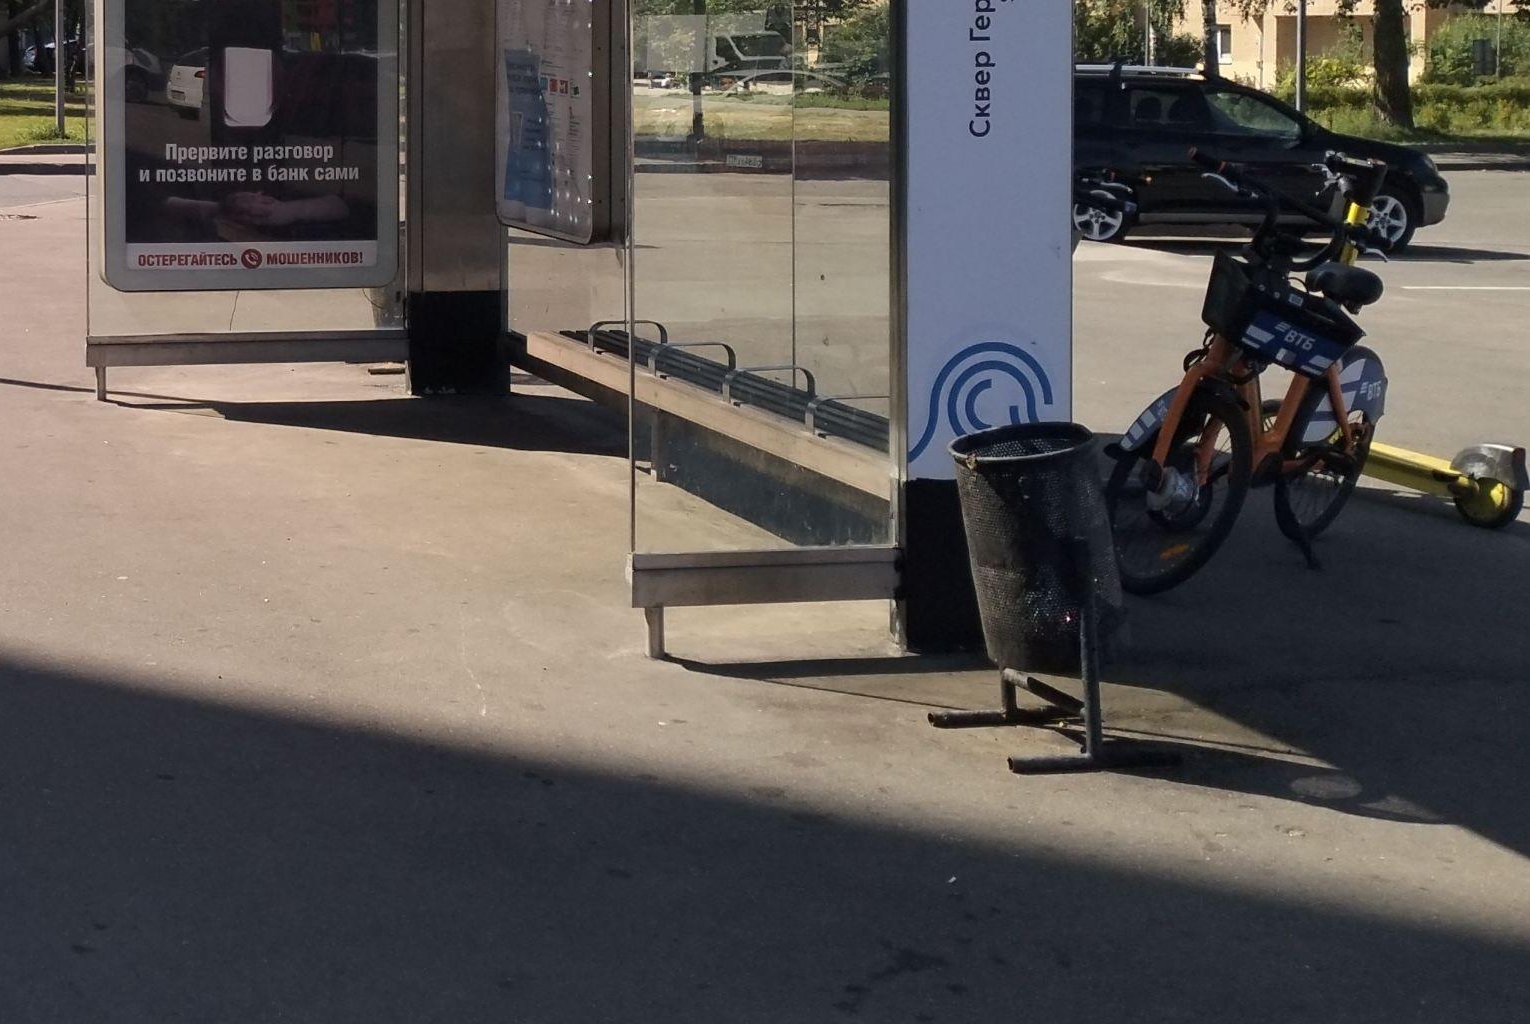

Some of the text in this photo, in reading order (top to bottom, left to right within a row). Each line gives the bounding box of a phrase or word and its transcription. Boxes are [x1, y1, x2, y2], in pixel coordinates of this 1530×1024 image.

[969, 51, 996, 137] Сквер
[166, 143, 334, 164] Прервите разговор
[139, 164, 359, 182] и позвоните в банк сами
[138, 251, 364, 267] ОСТЕРЕГАЙТЕСЬ МОШЕННИКОВ!
[1284, 329, 1316, 351] ВТБ
